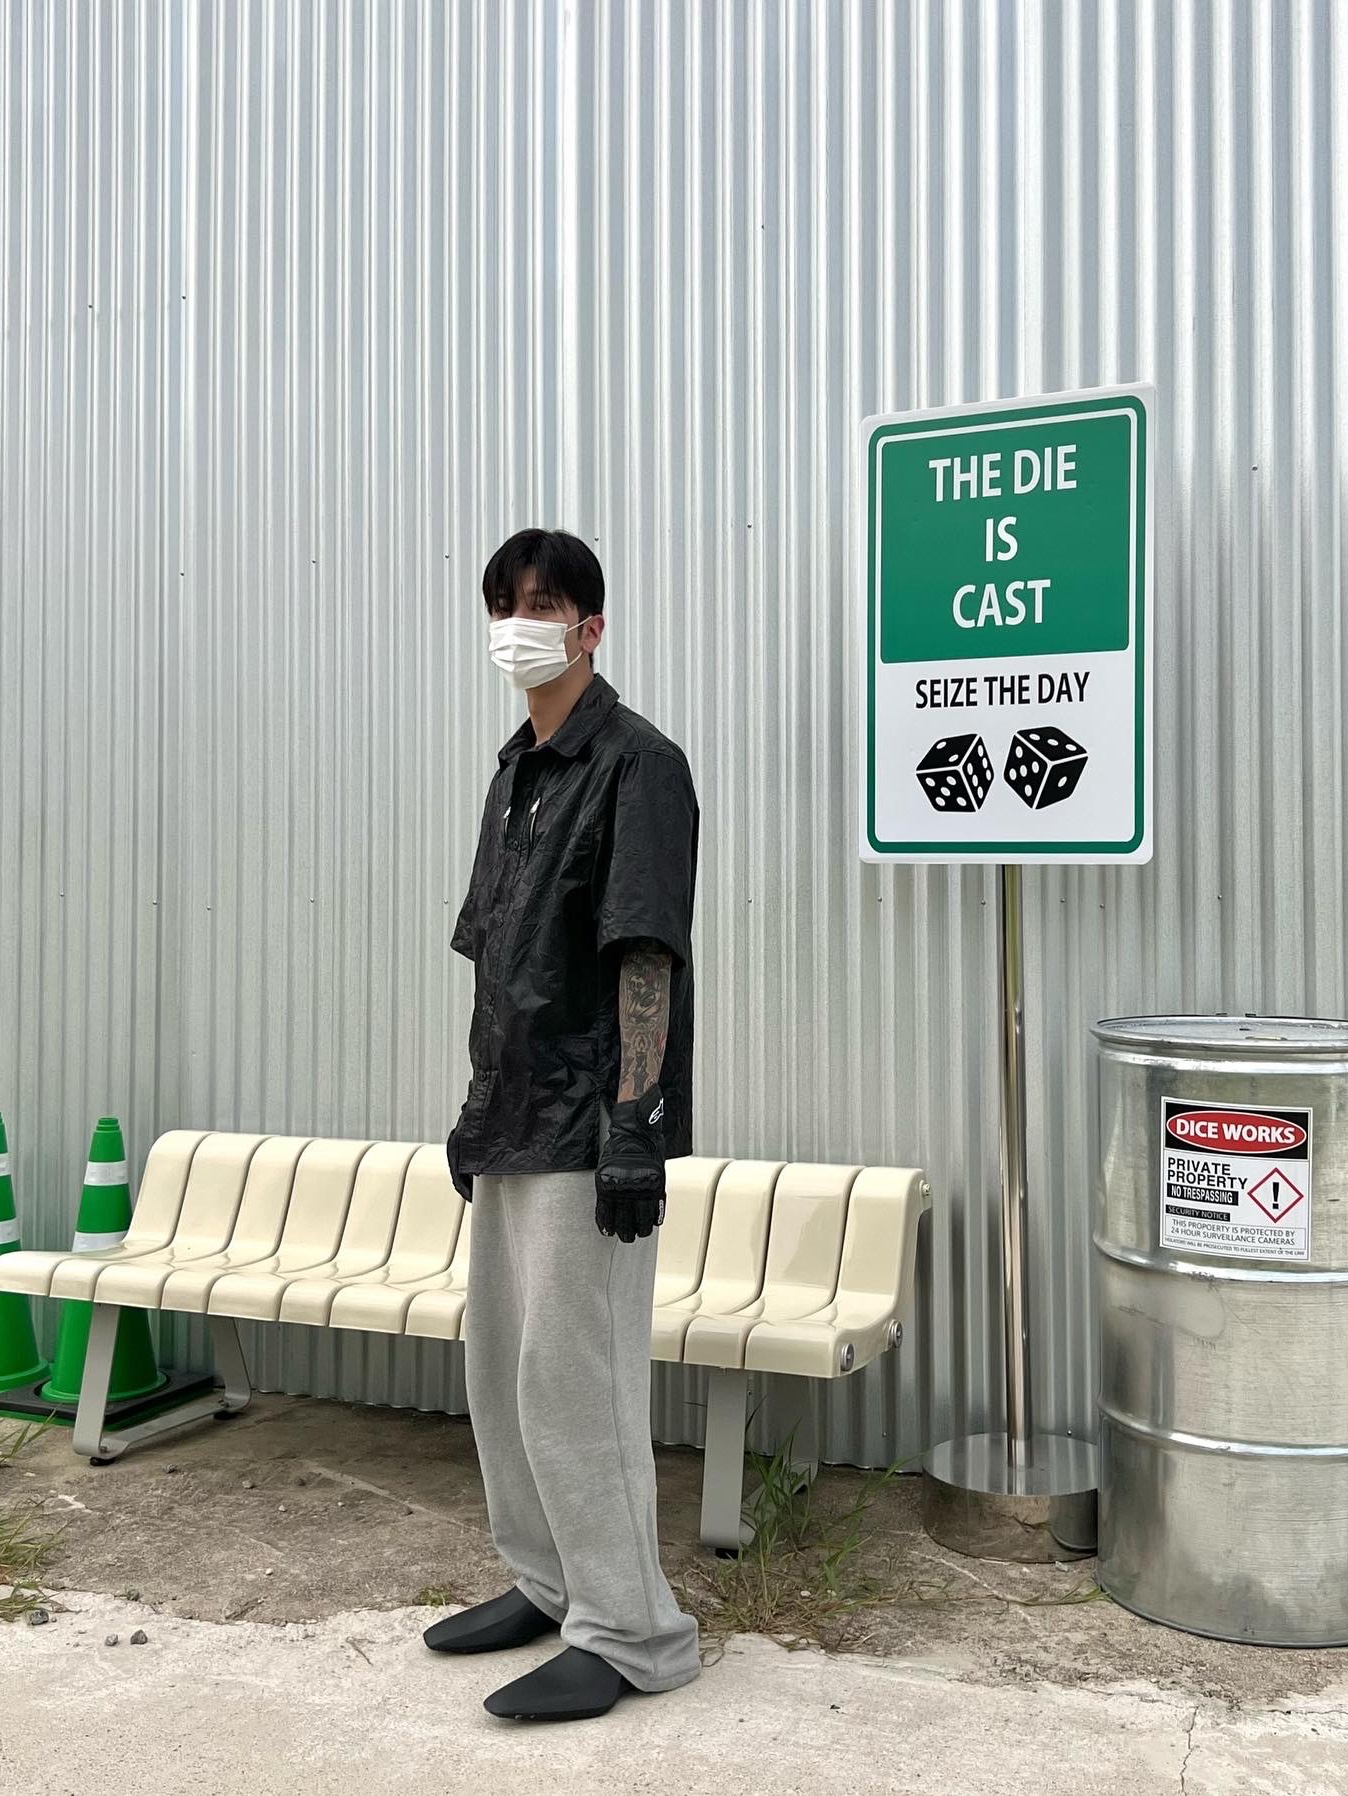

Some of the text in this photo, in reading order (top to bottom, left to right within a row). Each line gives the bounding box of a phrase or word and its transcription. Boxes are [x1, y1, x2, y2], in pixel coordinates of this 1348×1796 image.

[929, 444, 1077, 502] THE DIE
[985, 516, 1018, 562] IS
[952, 579, 1051, 629] CAST
[915, 671, 1090, 709] SEIZE THE DAY
[1176, 1118, 1296, 1144] DICE WORKS
[1168, 1157, 1231, 1176] PRIVATE
[1167, 1169, 1248, 1190] PROPERTY
[1171, 1184, 1233, 1204] NO TRESPASSING
[1168, 1206, 1228, 1220] SECURITY NOTICE
[1172, 1219, 1186, 1227] THIS
[1188, 1221, 1230, 1232] PROPOERTY
[1240, 1227, 1284, 1236] PROTECTED
[1181, 1228, 1201, 1237] HOUR
[1202, 1231, 1256, 1243] SURVEILLANCE
[1258, 1237, 1295, 1245] CAMERAS
